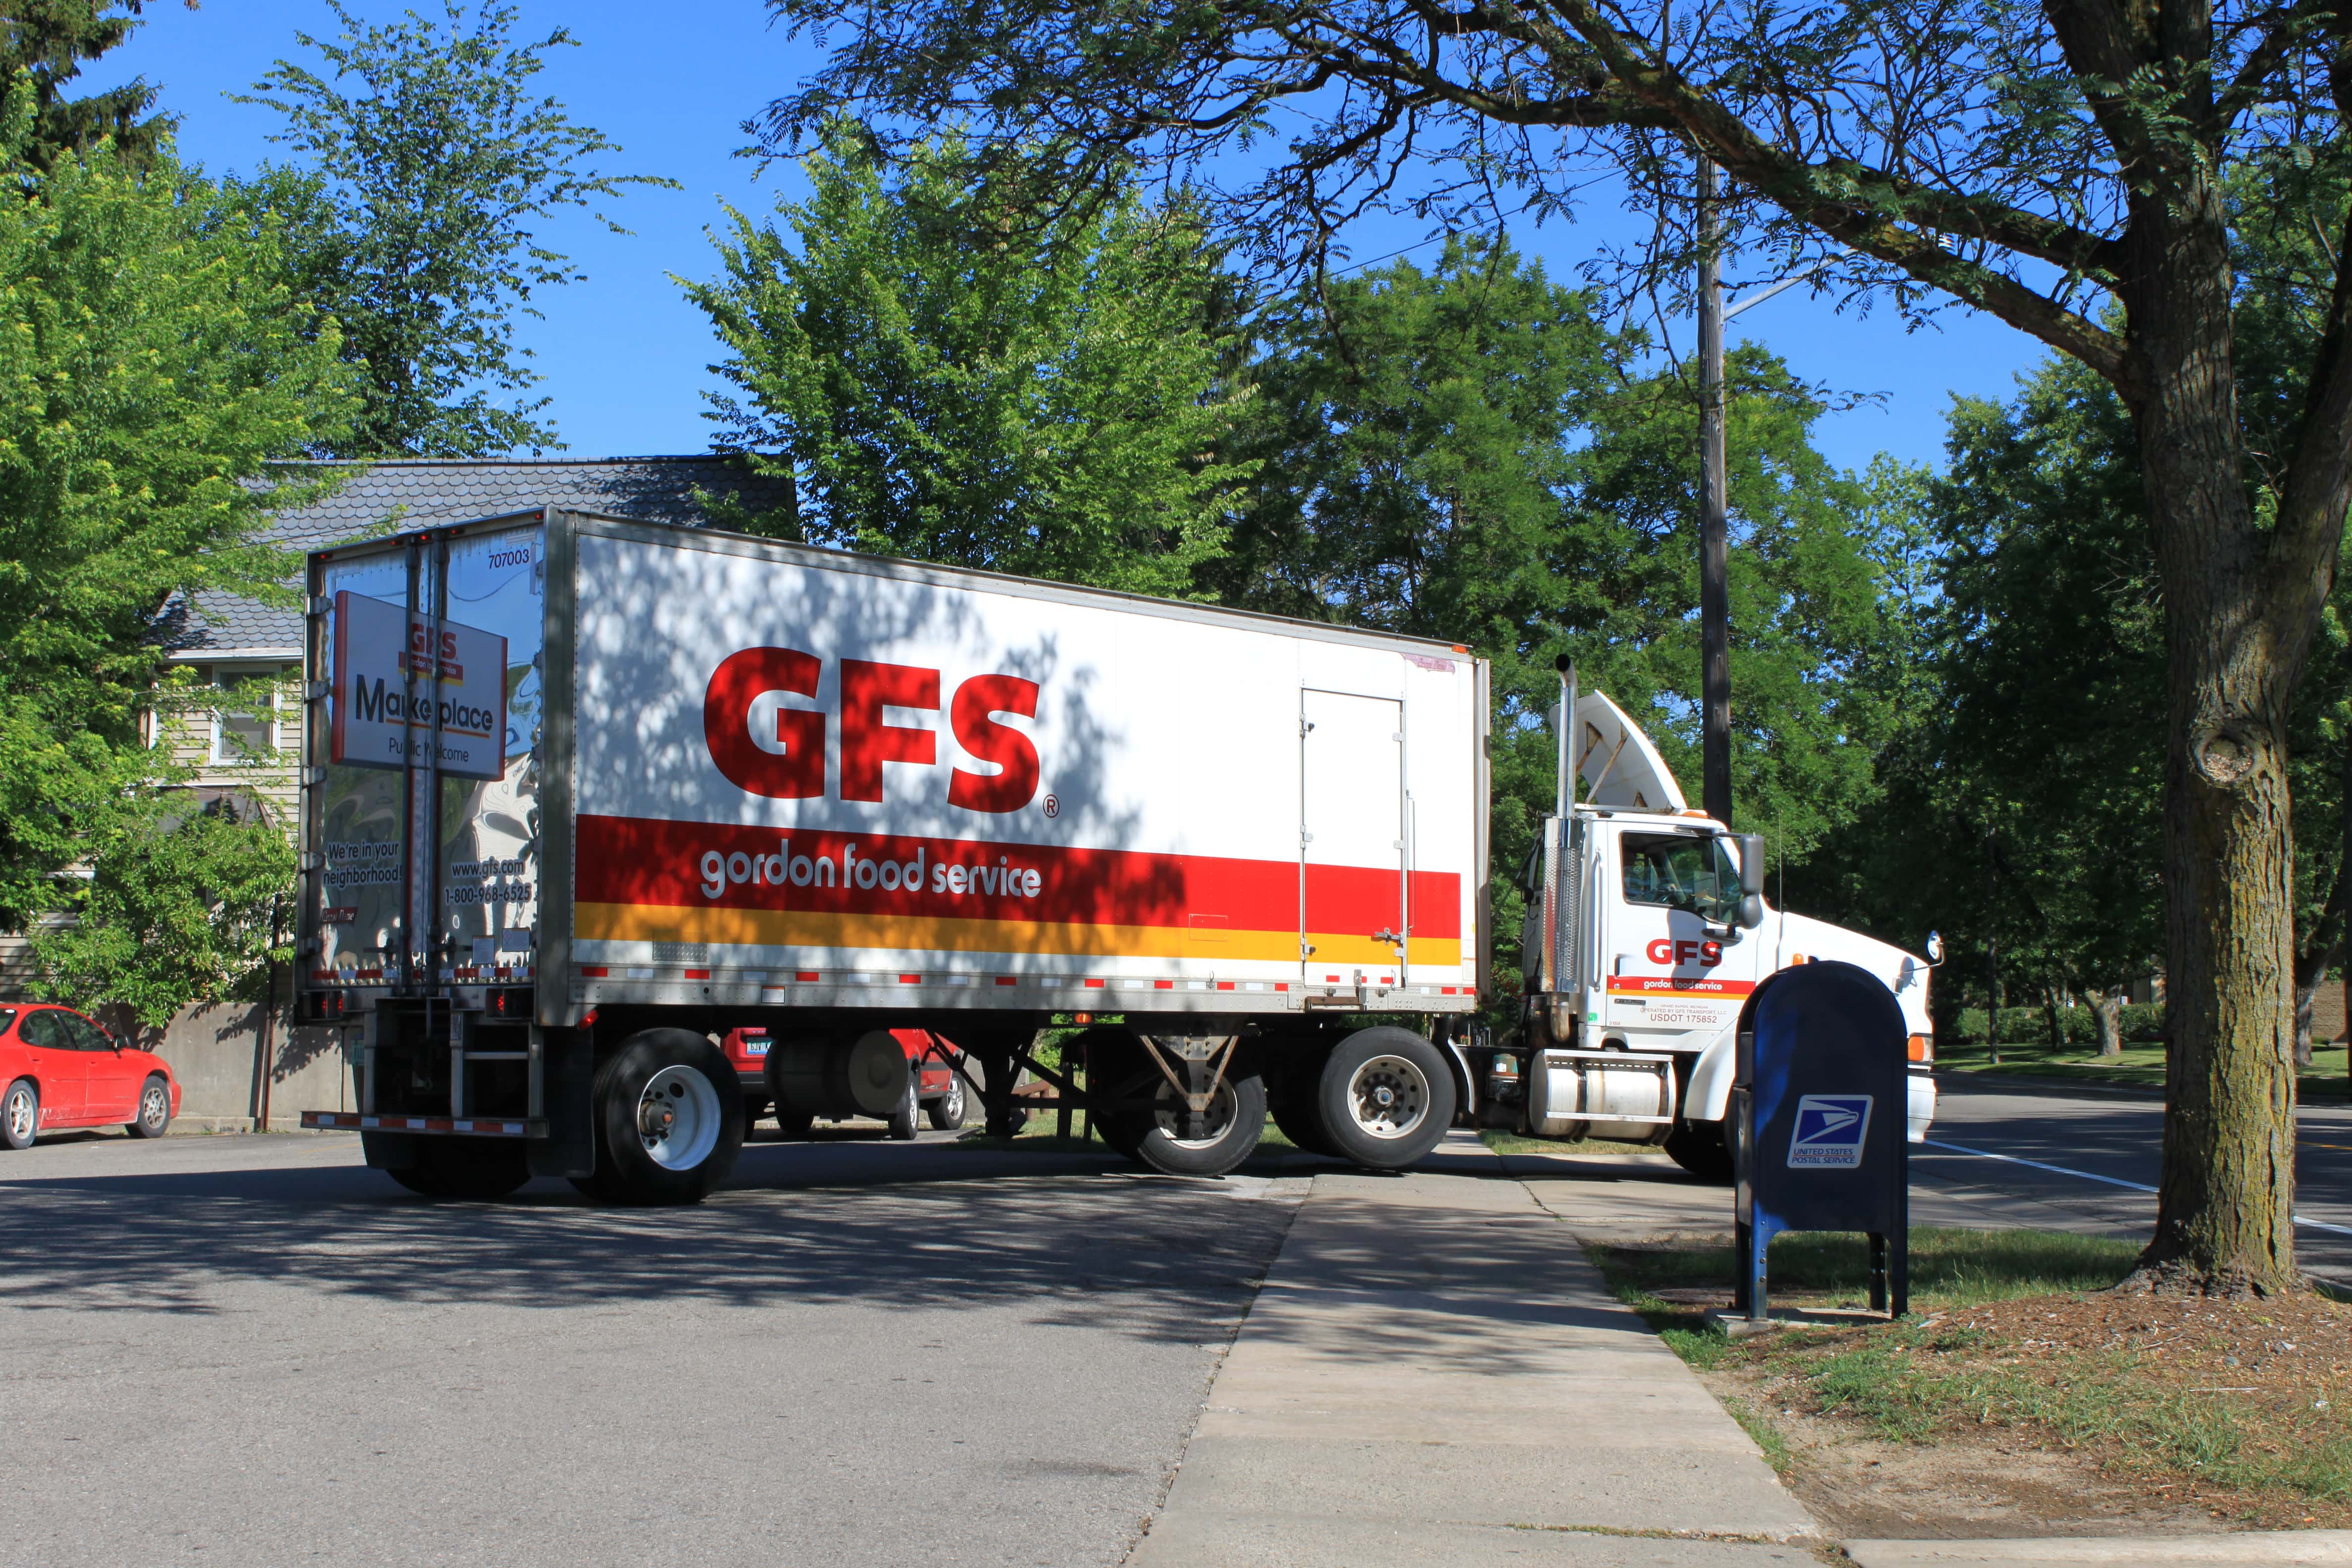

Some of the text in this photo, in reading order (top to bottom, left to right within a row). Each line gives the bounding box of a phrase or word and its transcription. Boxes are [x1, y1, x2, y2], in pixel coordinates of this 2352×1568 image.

[489, 549, 530, 570] 707003
[355, 673, 493, 732] Markeplace
[703, 646, 1040, 814] GFS
[389, 737, 421, 757] Pulic
[329, 841, 399, 861] We're in your
[323, 864, 402, 888] neighborhood!
[452, 858, 525, 878] www.gfs.com
[700, 838, 1042, 899] gordon food service
[445, 885, 531, 904] 1-800-968-6525
[1646, 938, 1723, 967] GFS
[1643, 979, 1723, 990] gordon food service
[1650, 1013, 1717, 1023] USDOT 175852
